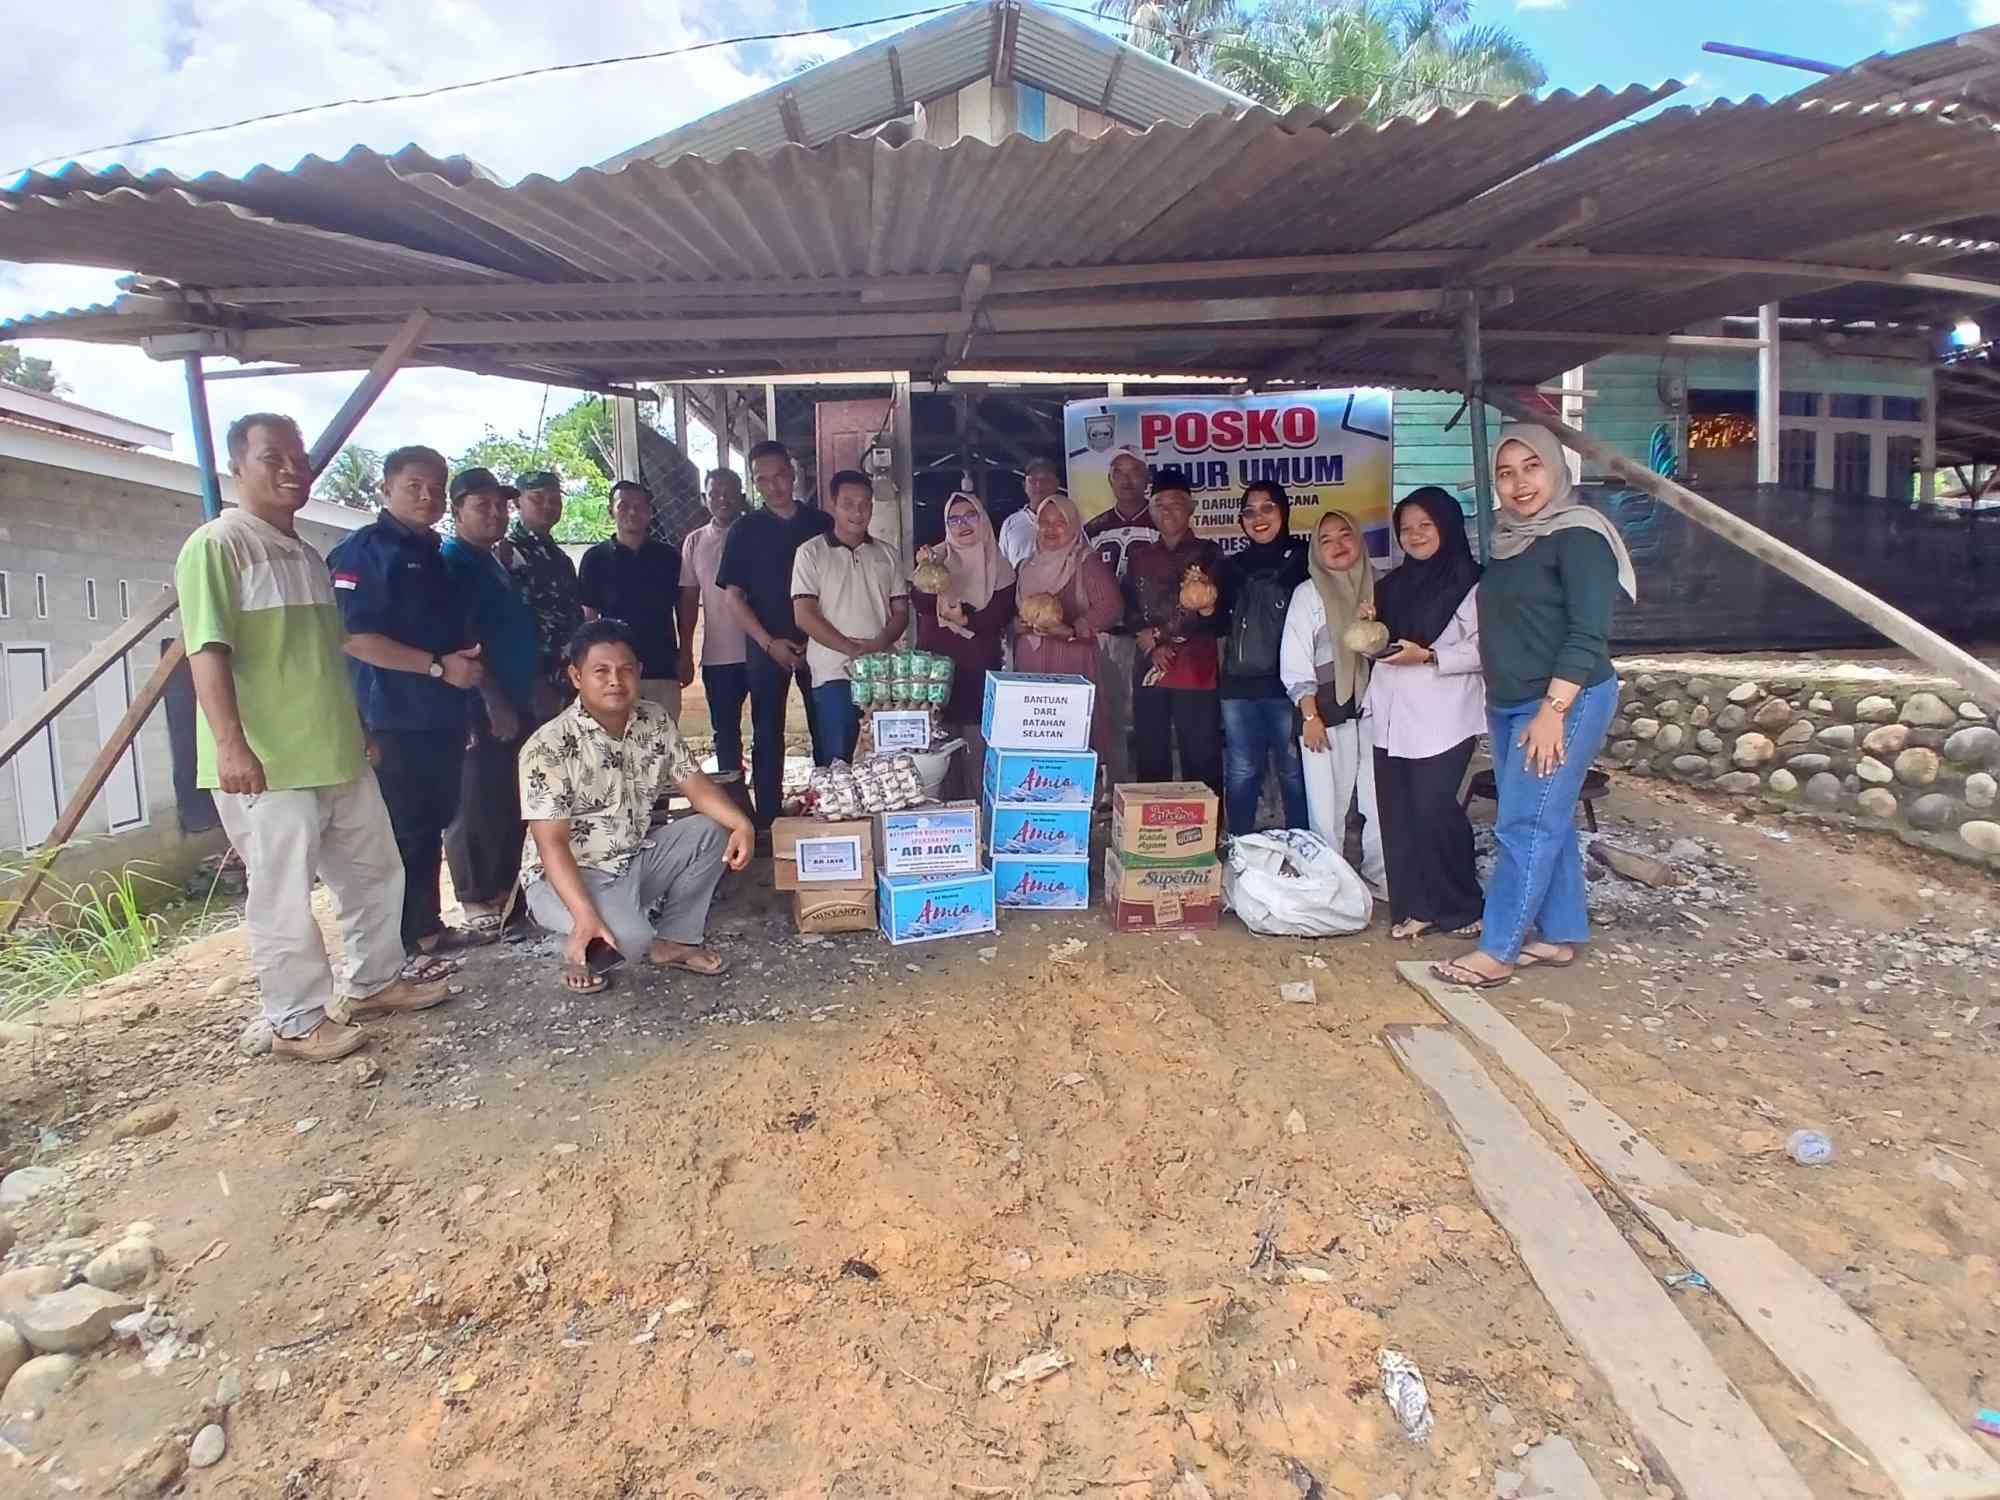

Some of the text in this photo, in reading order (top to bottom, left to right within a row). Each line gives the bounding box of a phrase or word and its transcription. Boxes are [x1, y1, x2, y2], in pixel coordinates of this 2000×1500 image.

[1140, 406, 1317, 452] POSKO
[1239, 454, 1344, 488] UMUM
[1193, 513, 1234, 526] TAHUN
[1023, 695, 1069, 705] BANTUAN
[1033, 707, 1057, 716] DARI
[1022, 718, 1066, 727] BATAHAN
[1022, 729, 1063, 739] SELATAN
[1018, 767, 1073, 791] Amia
[1012, 819, 1068, 843] Amia
[902, 844, 962, 857] AR JAYA
[1012, 871, 1069, 895] Amia
[914, 899, 974, 924] Amia
